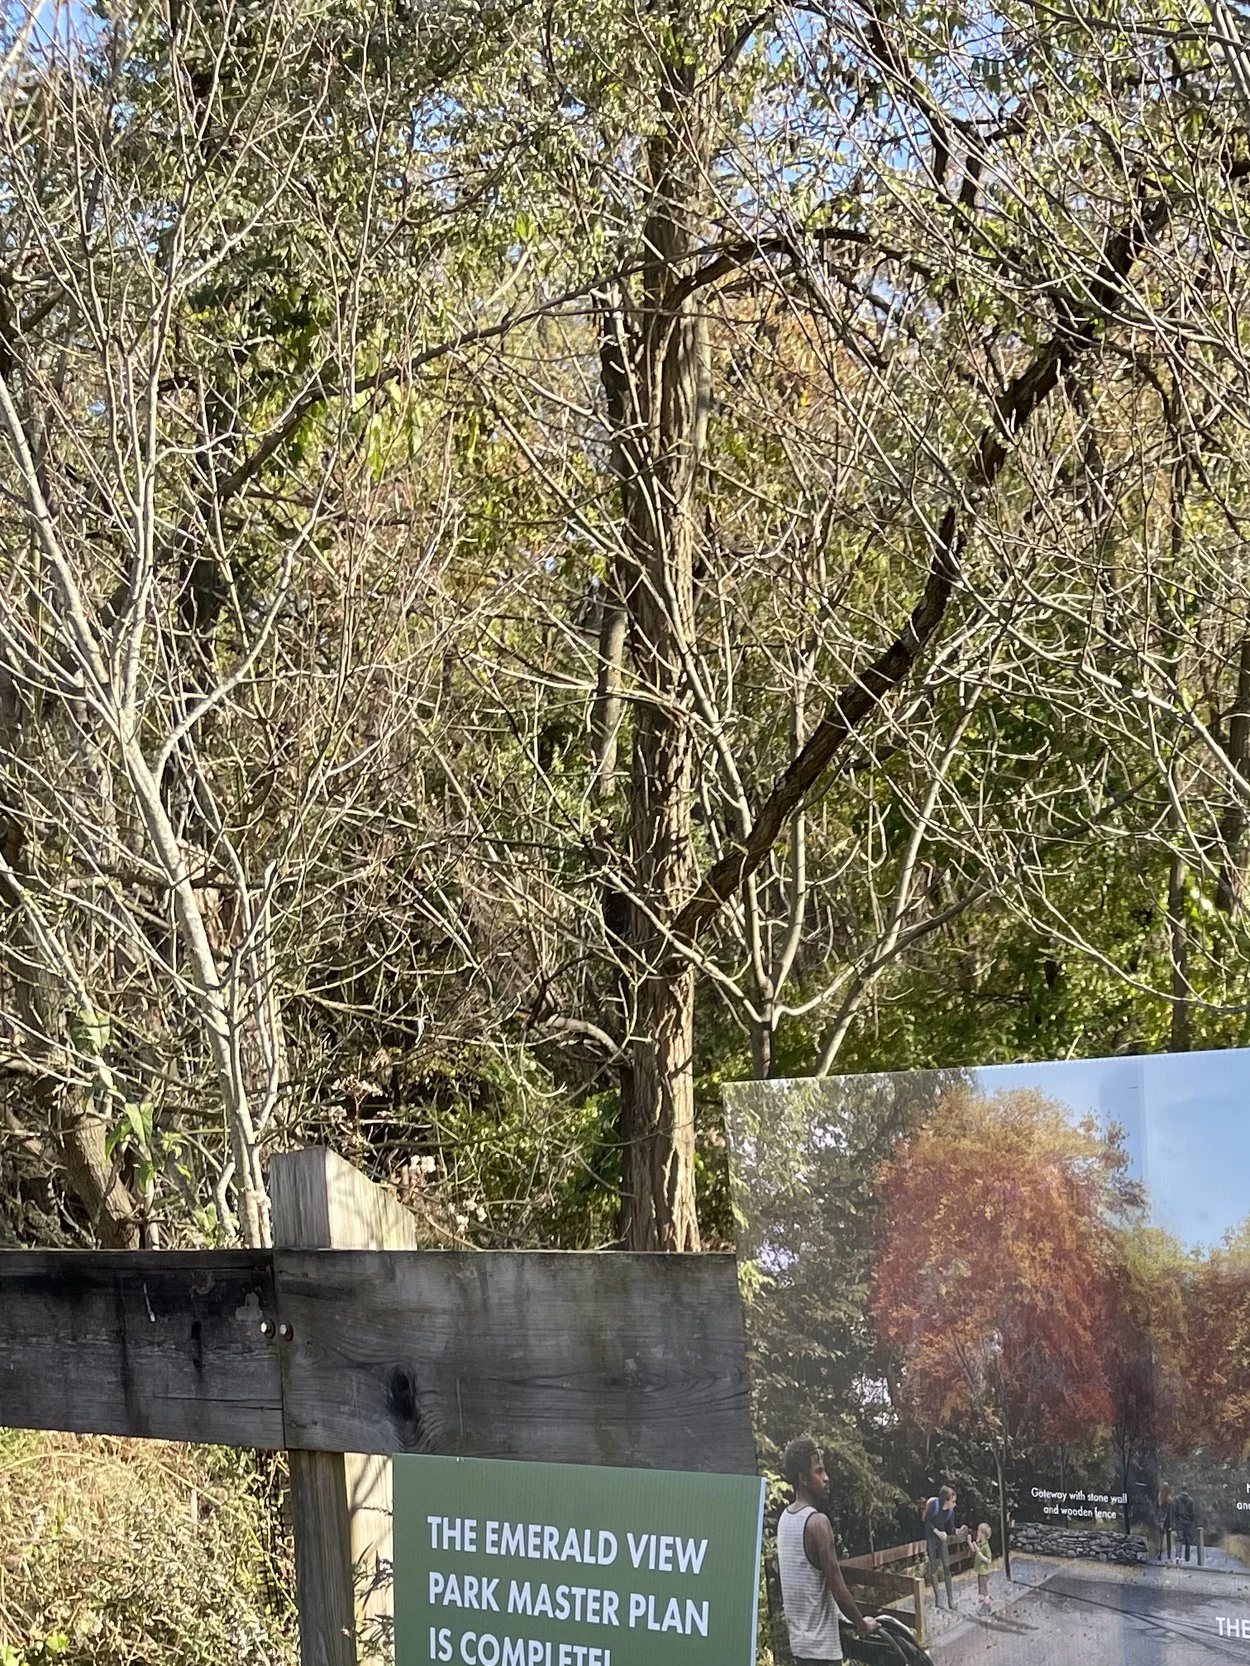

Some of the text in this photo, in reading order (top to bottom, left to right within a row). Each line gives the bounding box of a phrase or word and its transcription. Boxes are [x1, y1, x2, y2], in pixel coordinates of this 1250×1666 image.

[426, 1515, 708, 1574] THE EMERALD VIEW
[429, 1571, 709, 1637] PARK MASTER PLAN
[1215, 1616, 1250, 1639] THE
[429, 1626, 453, 1661] IS
